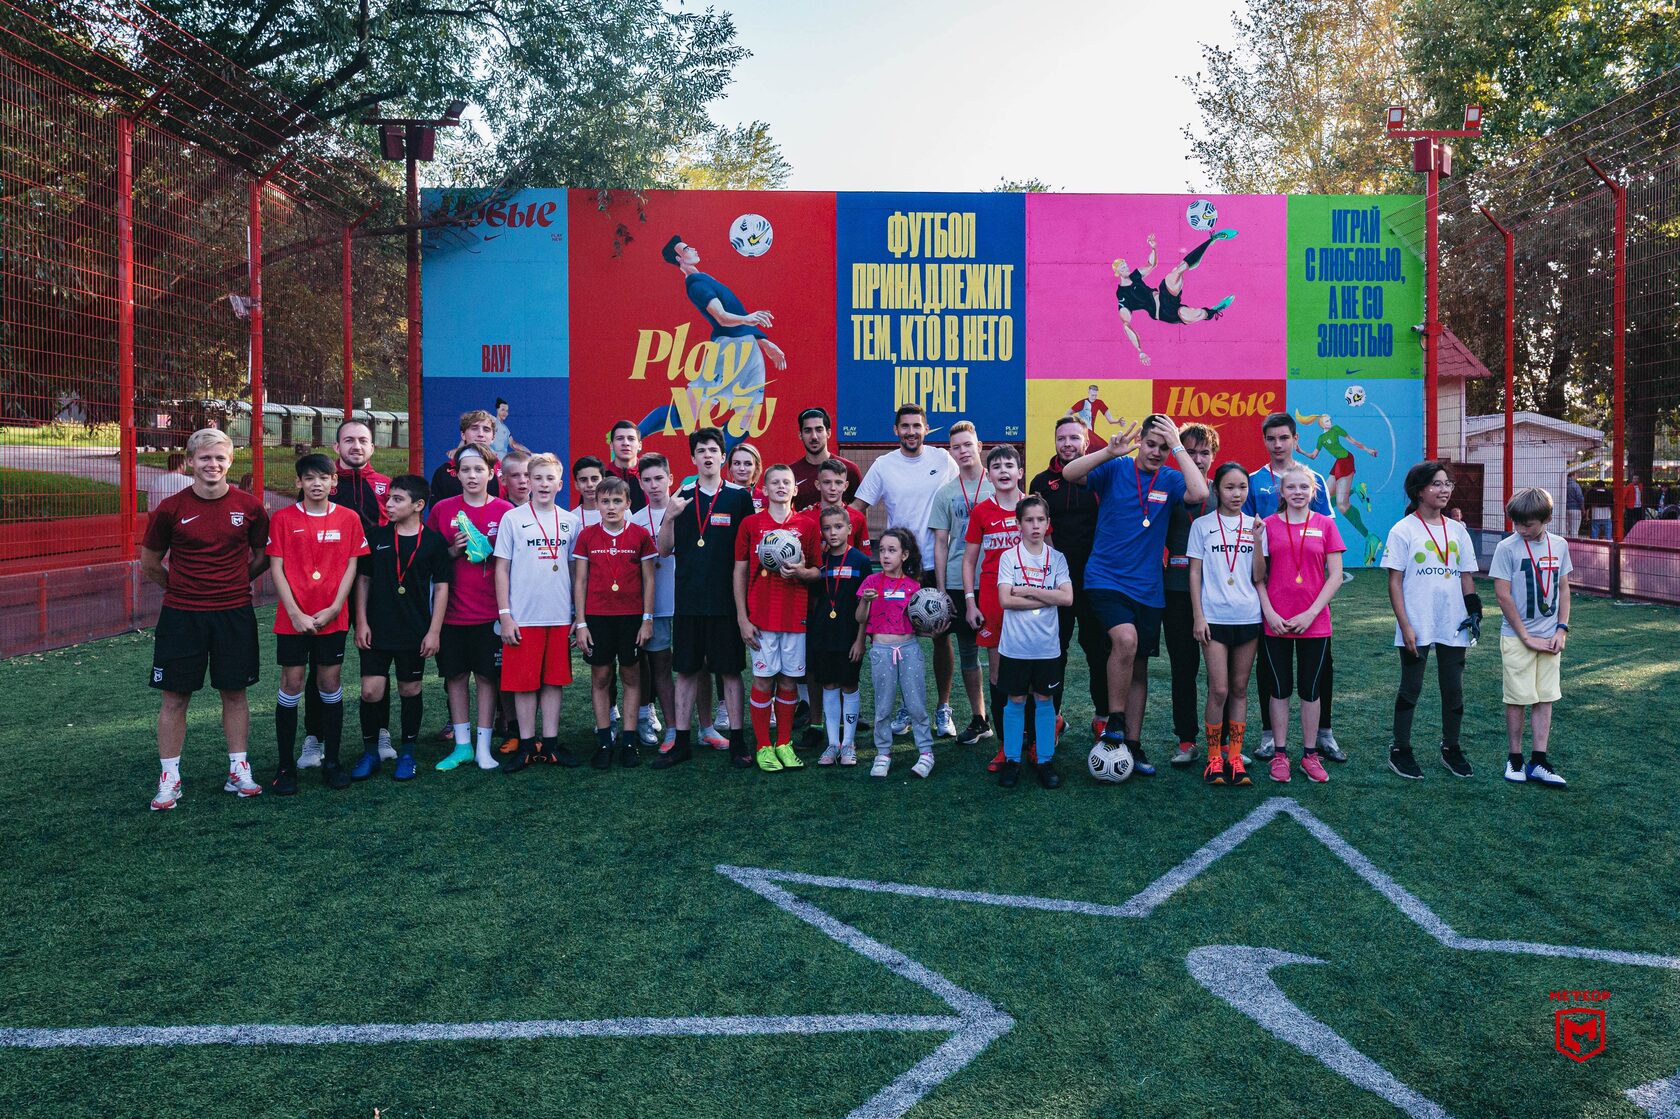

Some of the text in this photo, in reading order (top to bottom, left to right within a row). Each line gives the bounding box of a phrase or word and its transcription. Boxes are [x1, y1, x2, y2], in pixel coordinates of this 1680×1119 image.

[431, 195, 557, 228] овые
[1332, 205, 1381, 244] ИГРАЙ
[887, 211, 977, 258] ФУТБОЛ
[1305, 247, 1406, 285] С ЛЮБОВЬЮ,
[852, 263, 1014, 314] ПРИНАДЛЕЖИТ
[1328, 286, 1383, 320] А НЕ СО
[481, 344, 511, 373] ВАУ!
[851, 315, 1013, 364] ТЕМ, КТО В НЕГО
[1317, 323, 1393, 357] ЗЛОСТЬЮ
[628, 322, 753, 396] Play
[894, 366, 969, 413] ИГРАЕТ
[1165, 386, 1276, 417] Новые
[662, 386, 777, 438] New
[612, 538, 617, 547] 1
[989, 535, 1021, 547] ЛУКО
[1520, 558, 1559, 619] 10
